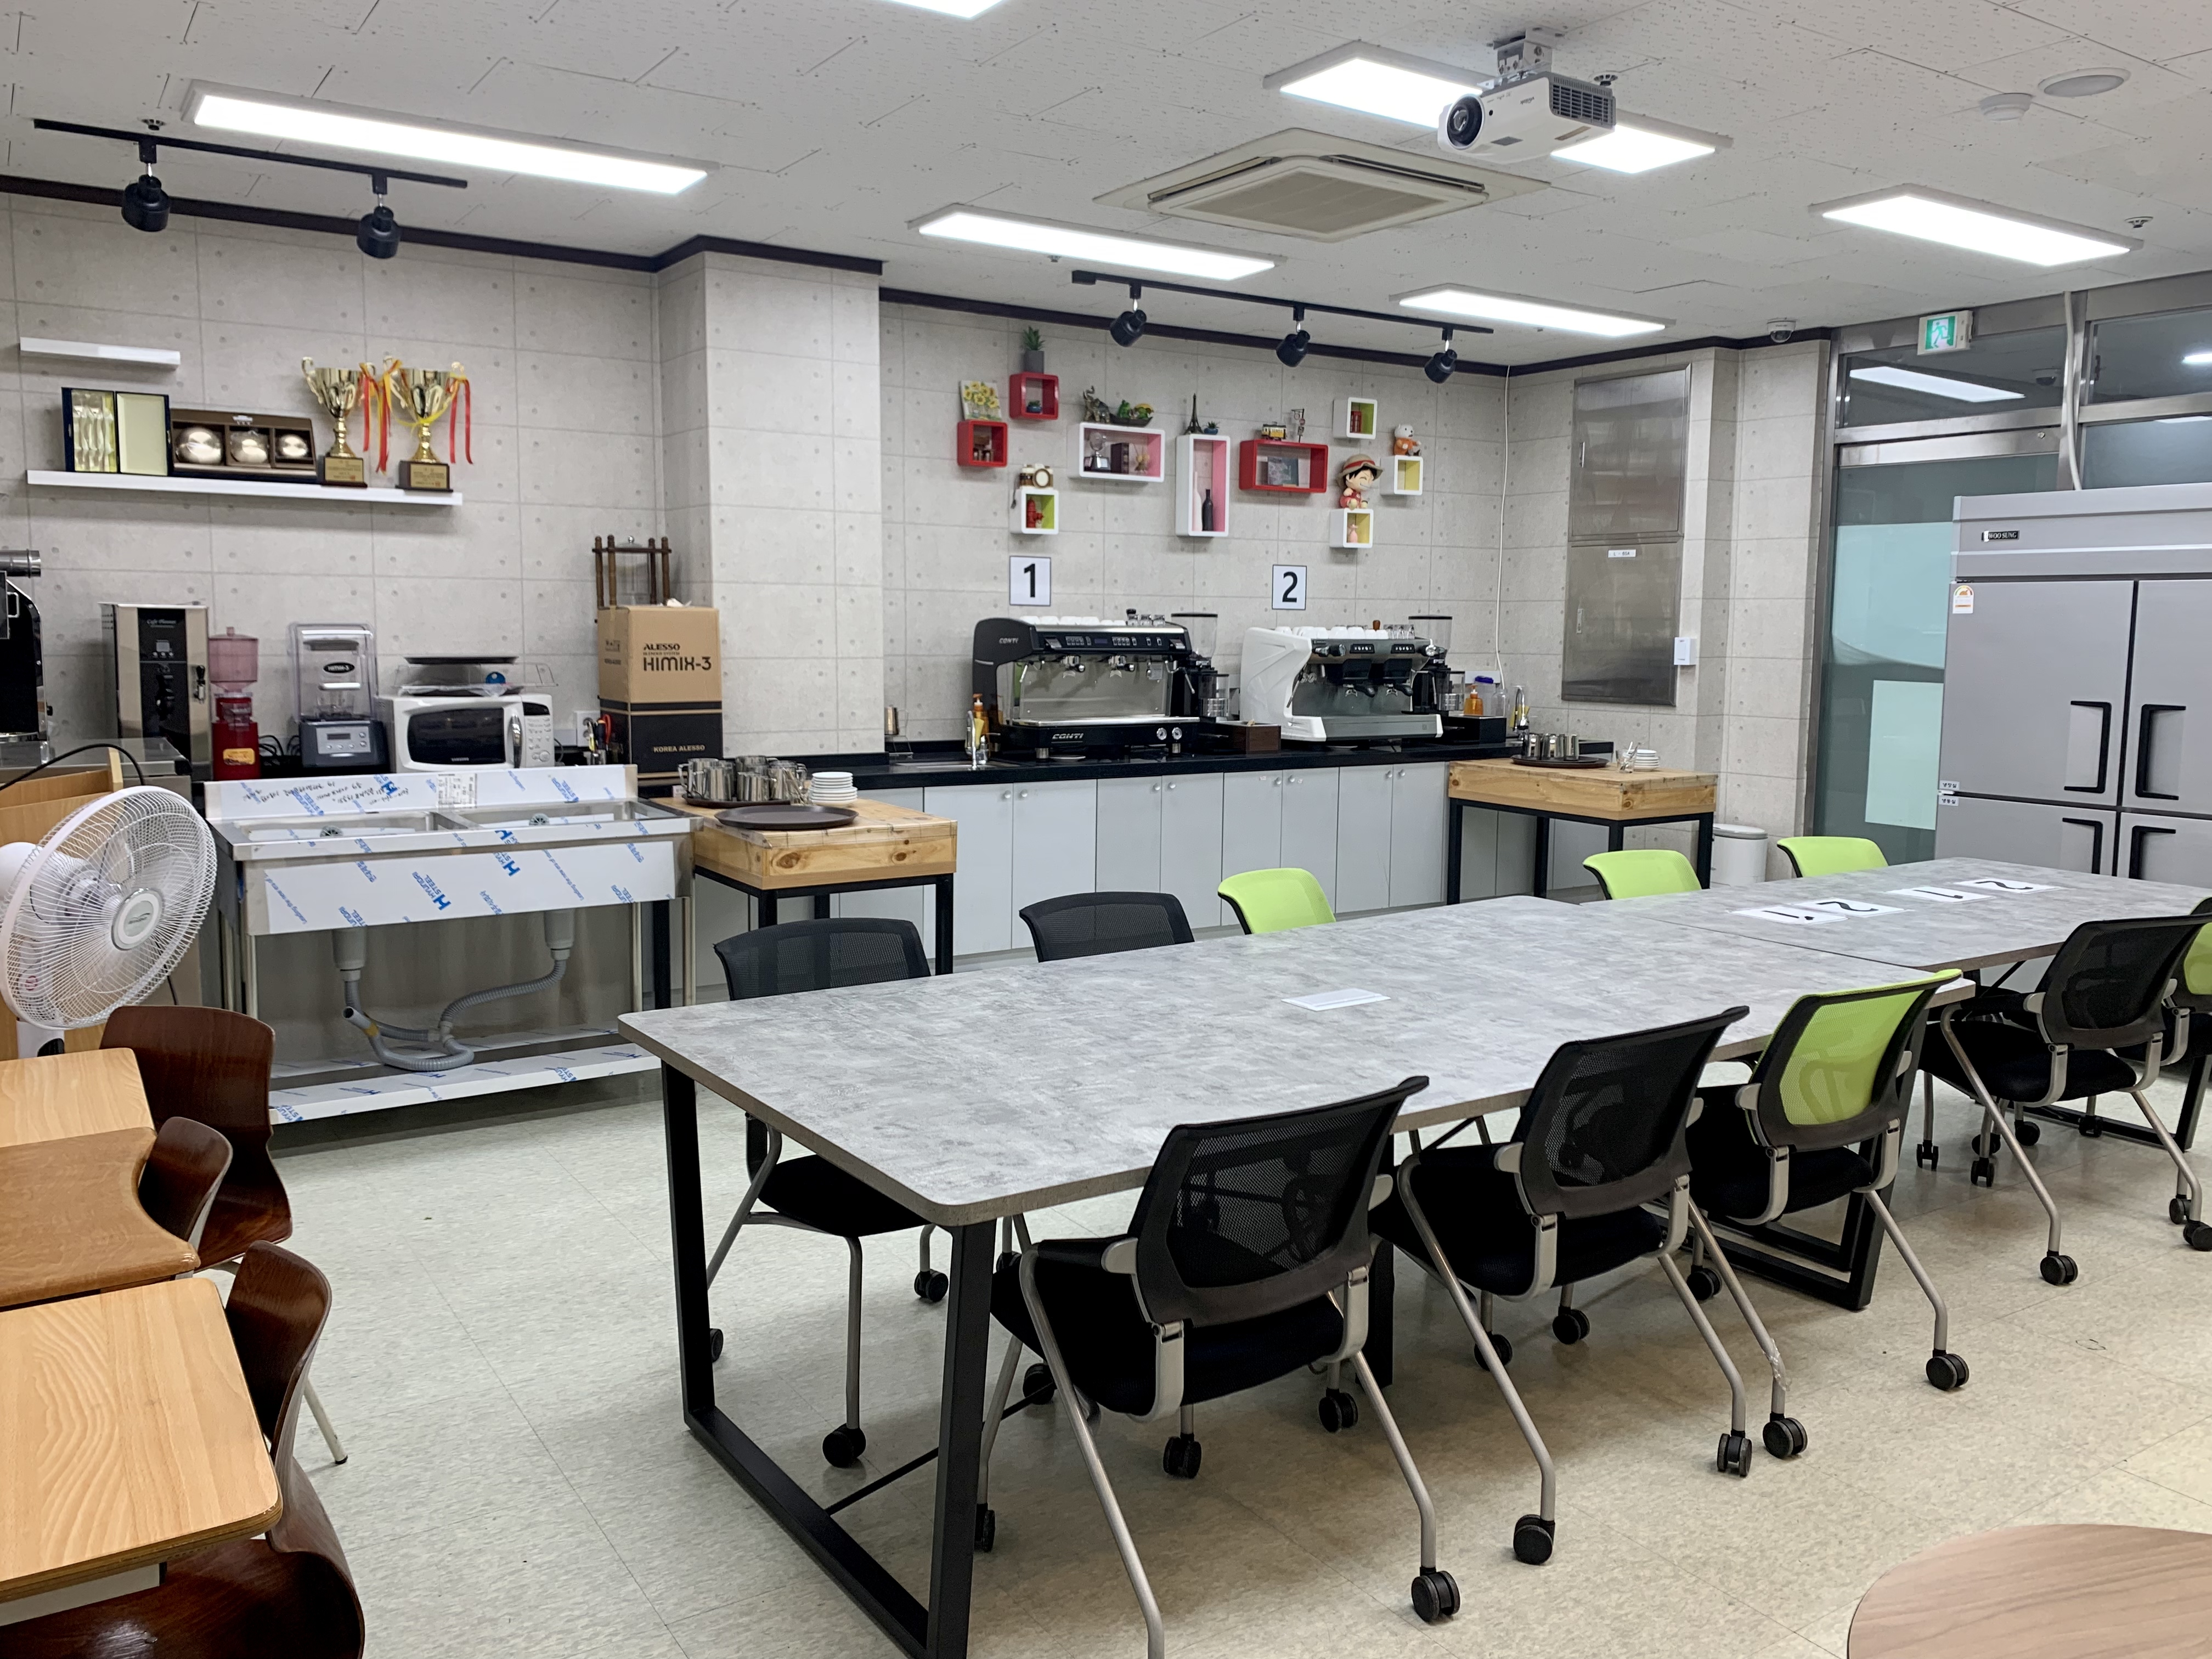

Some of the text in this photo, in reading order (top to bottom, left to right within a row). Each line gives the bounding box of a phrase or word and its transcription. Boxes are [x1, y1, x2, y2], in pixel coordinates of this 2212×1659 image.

[1023, 563, 1036, 597] 1
[1282, 571, 1298, 602] 2
[644, 656, 712, 671] HIMIX-3
[411, 871, 436, 899] HYUNDAI
[424, 874, 442, 895] STEEL
[571, 884, 584, 901] Leading
[284, 899, 293, 908] the
[1816, 901, 1879, 912] 2
[291, 906, 307, 924] Leading
